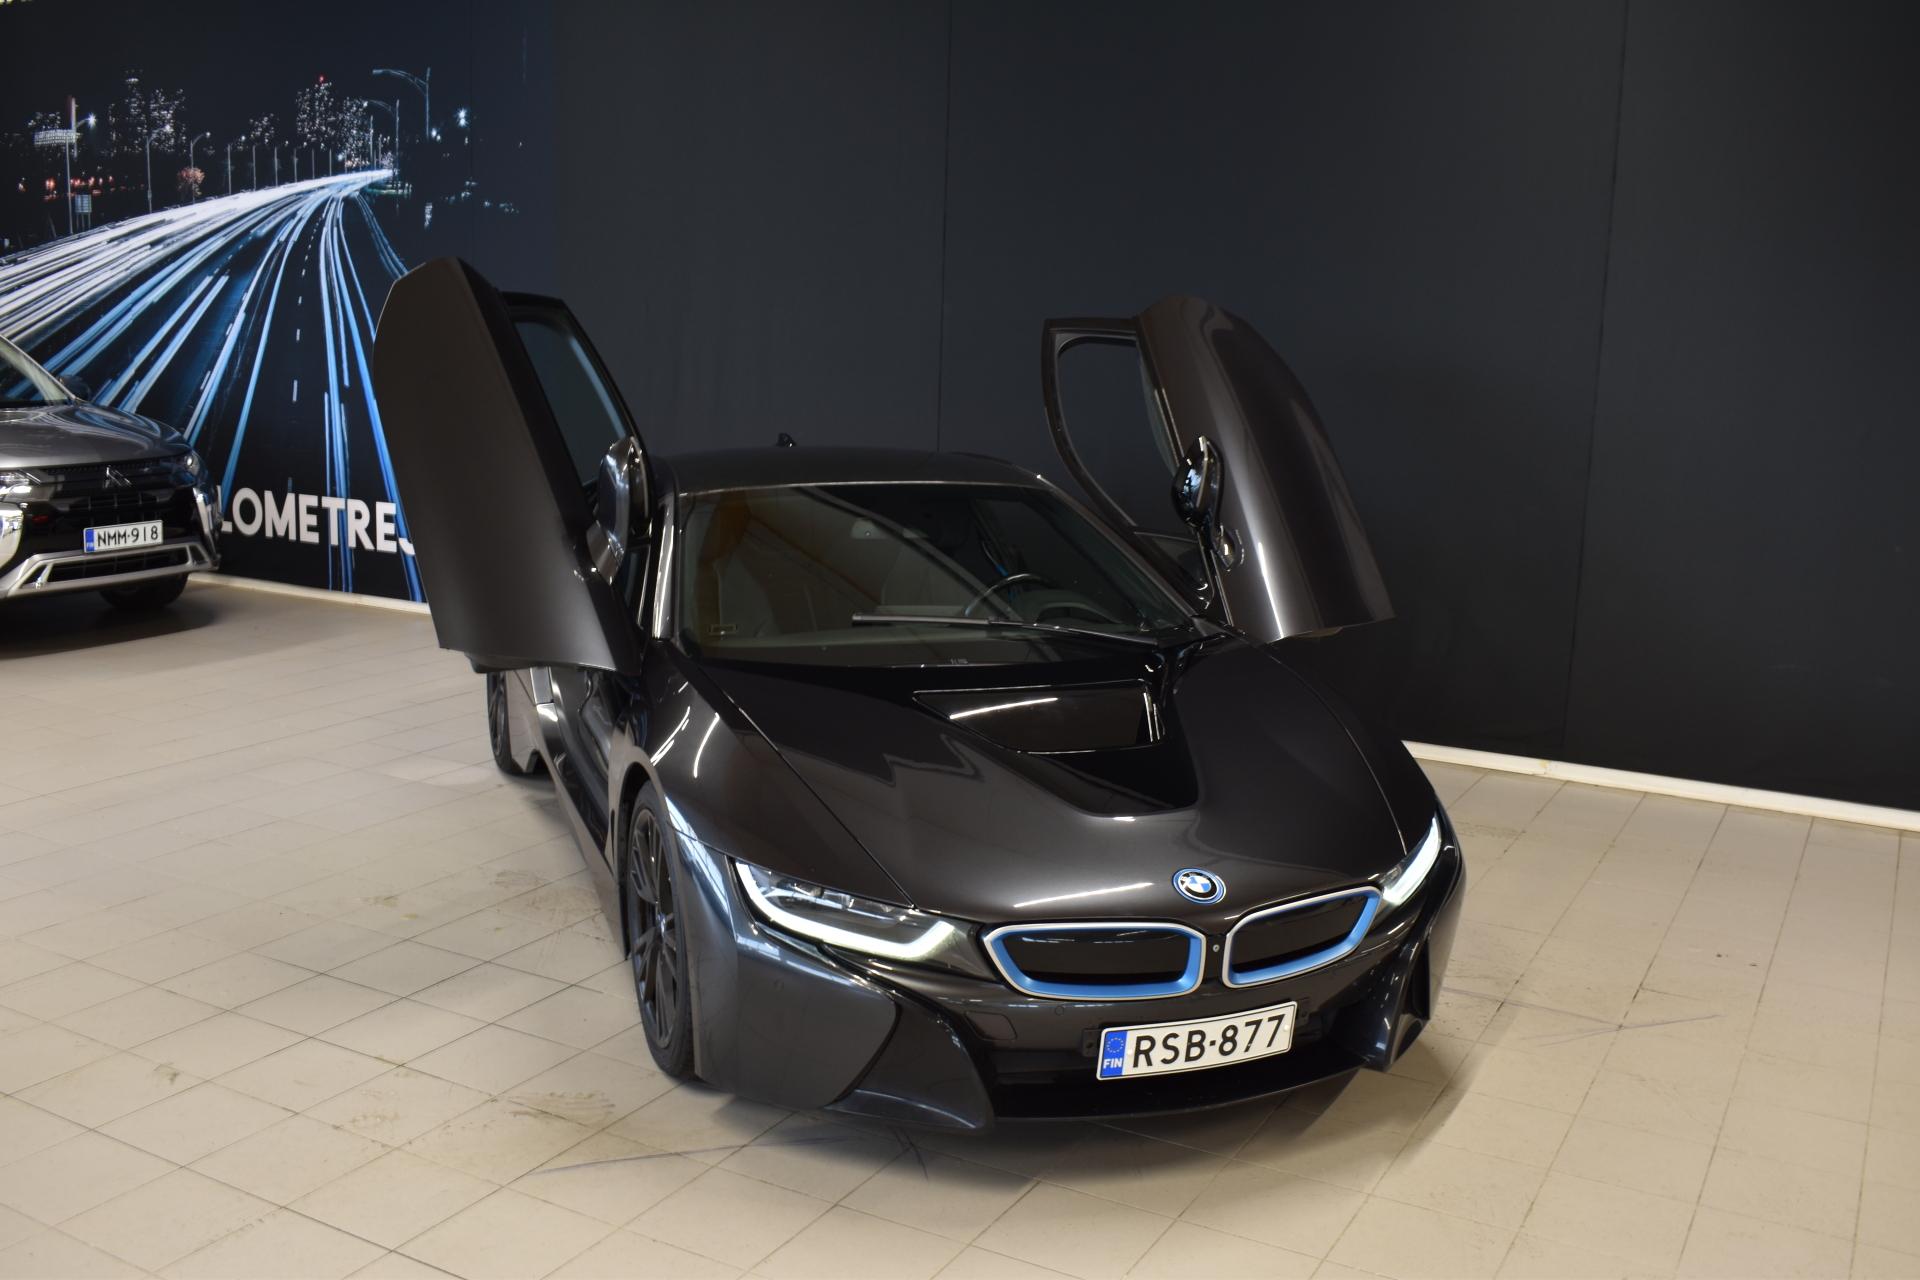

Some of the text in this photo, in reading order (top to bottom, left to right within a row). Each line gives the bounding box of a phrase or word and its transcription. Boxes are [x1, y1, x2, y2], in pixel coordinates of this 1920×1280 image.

[97, 525, 158, 547] NMM-918
[216, 485, 416, 556] LOMETRE
[1132, 1013, 1286, 1068] RSB-877
[1102, 1057, 1123, 1069] FIN
